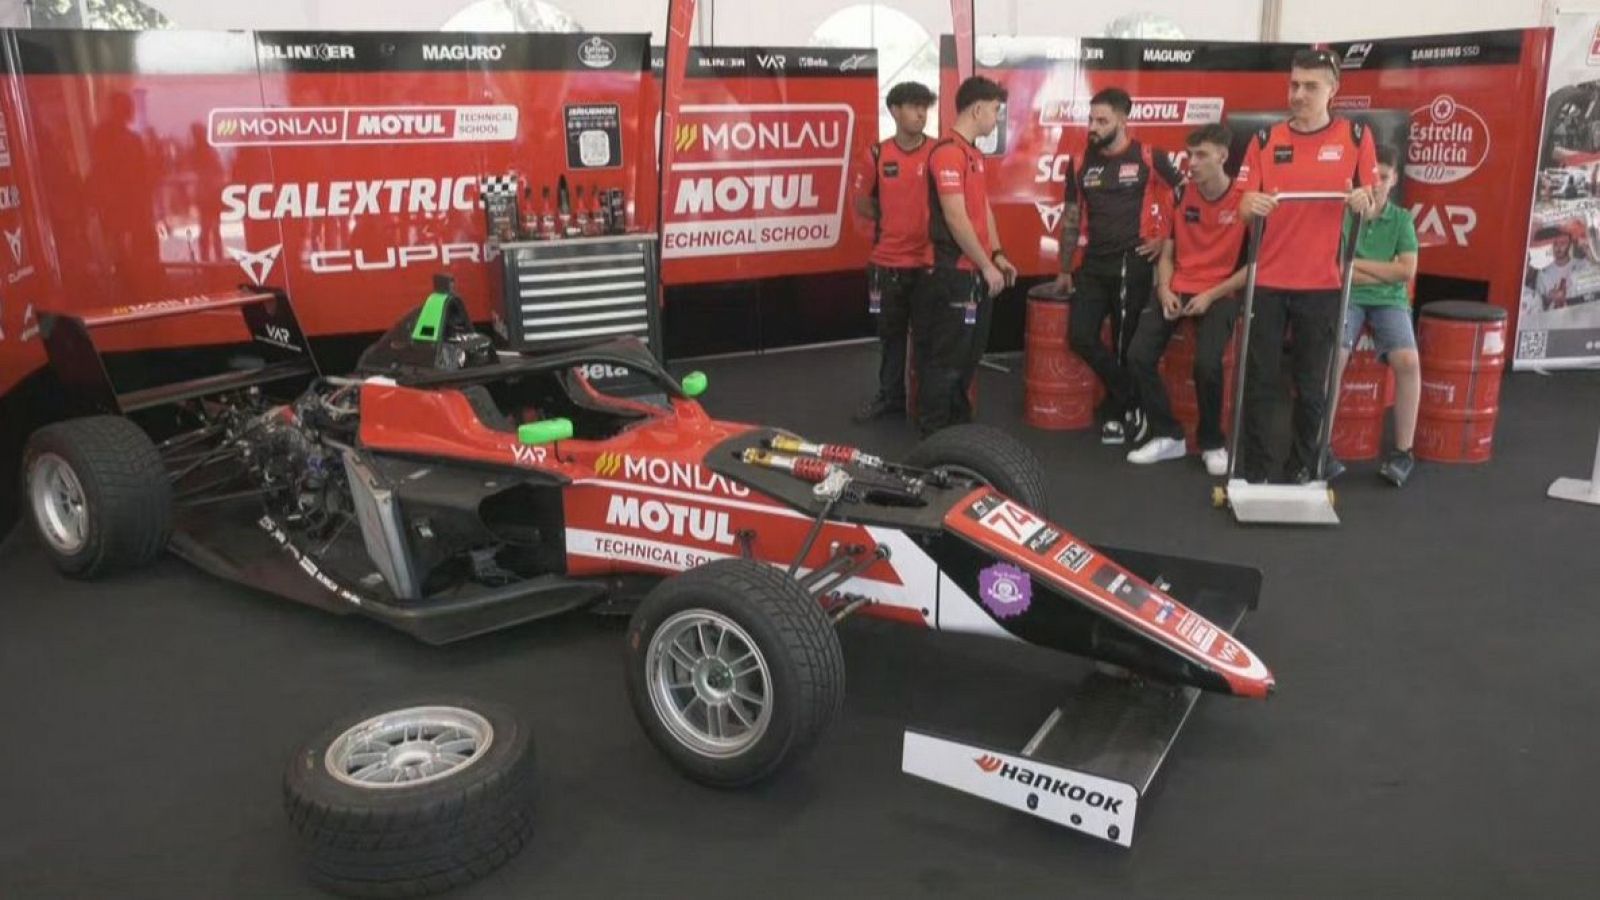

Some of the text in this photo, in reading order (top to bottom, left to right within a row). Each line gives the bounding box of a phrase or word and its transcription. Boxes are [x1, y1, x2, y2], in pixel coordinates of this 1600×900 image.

[756, 54, 786, 69] VAR
[1130, 103, 1180, 119] MOTUL
[239, 117, 337, 136] MONLAU
[357, 113, 445, 135] MOTUL
[1408, 120, 1473, 142] Estrella
[702, 121, 839, 150] MONLAU
[1408, 143, 1467, 164] Galicia
[220, 178, 478, 221] SCALEXTRIC
[674, 174, 819, 214] MOTUL
[664, 224, 831, 249] ECHNICAL SCHOOL
[265, 324, 290, 343] VAR
[510, 444, 547, 463] VAR
[606, 495, 735, 545] MOTUL
[988, 503, 1036, 540] 74
[595, 537, 681, 565] TECHNICAL
